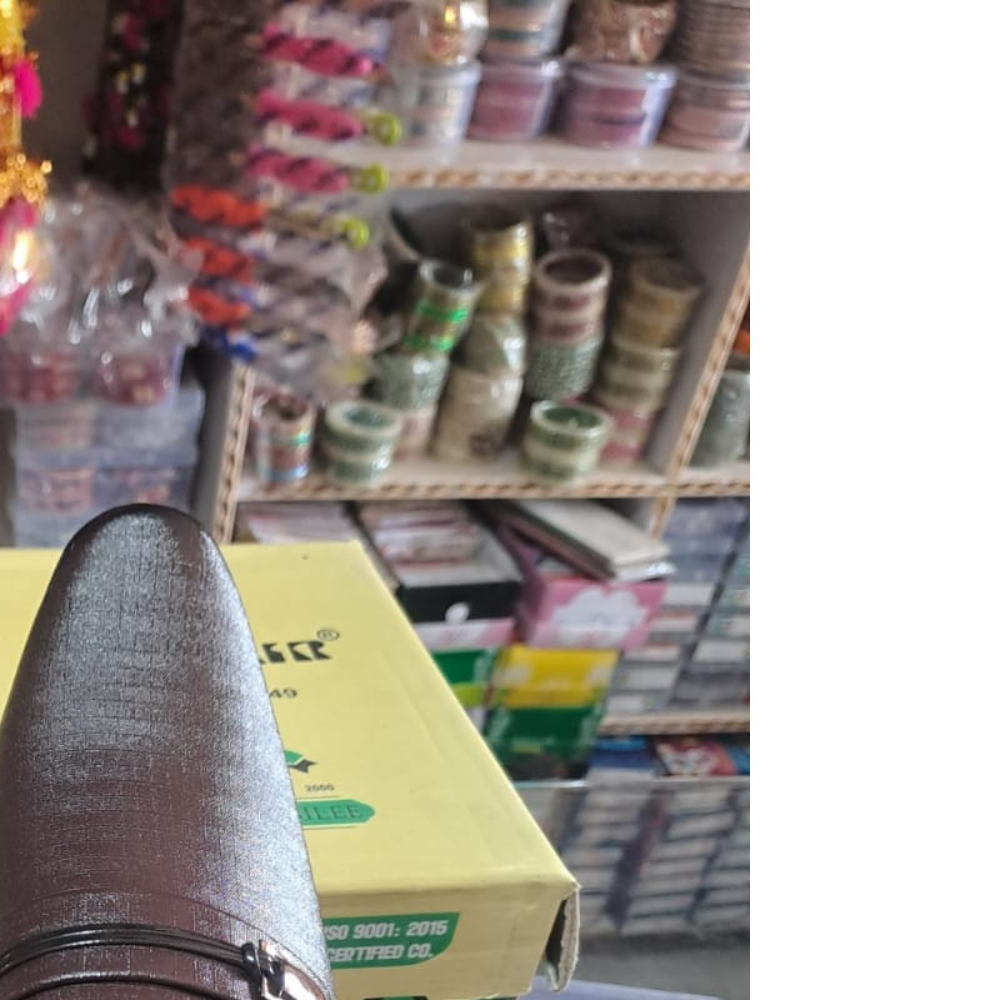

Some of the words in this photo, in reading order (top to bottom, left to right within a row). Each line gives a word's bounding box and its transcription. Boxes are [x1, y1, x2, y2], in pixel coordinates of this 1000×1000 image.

[299, 804, 364, 821] ILEE
[353, 922, 401, 940] 9001:
[405, 919, 449, 937] 2015
[328, 944, 405, 962] CERTIFIED
[407, 942, 434, 959] CO.
